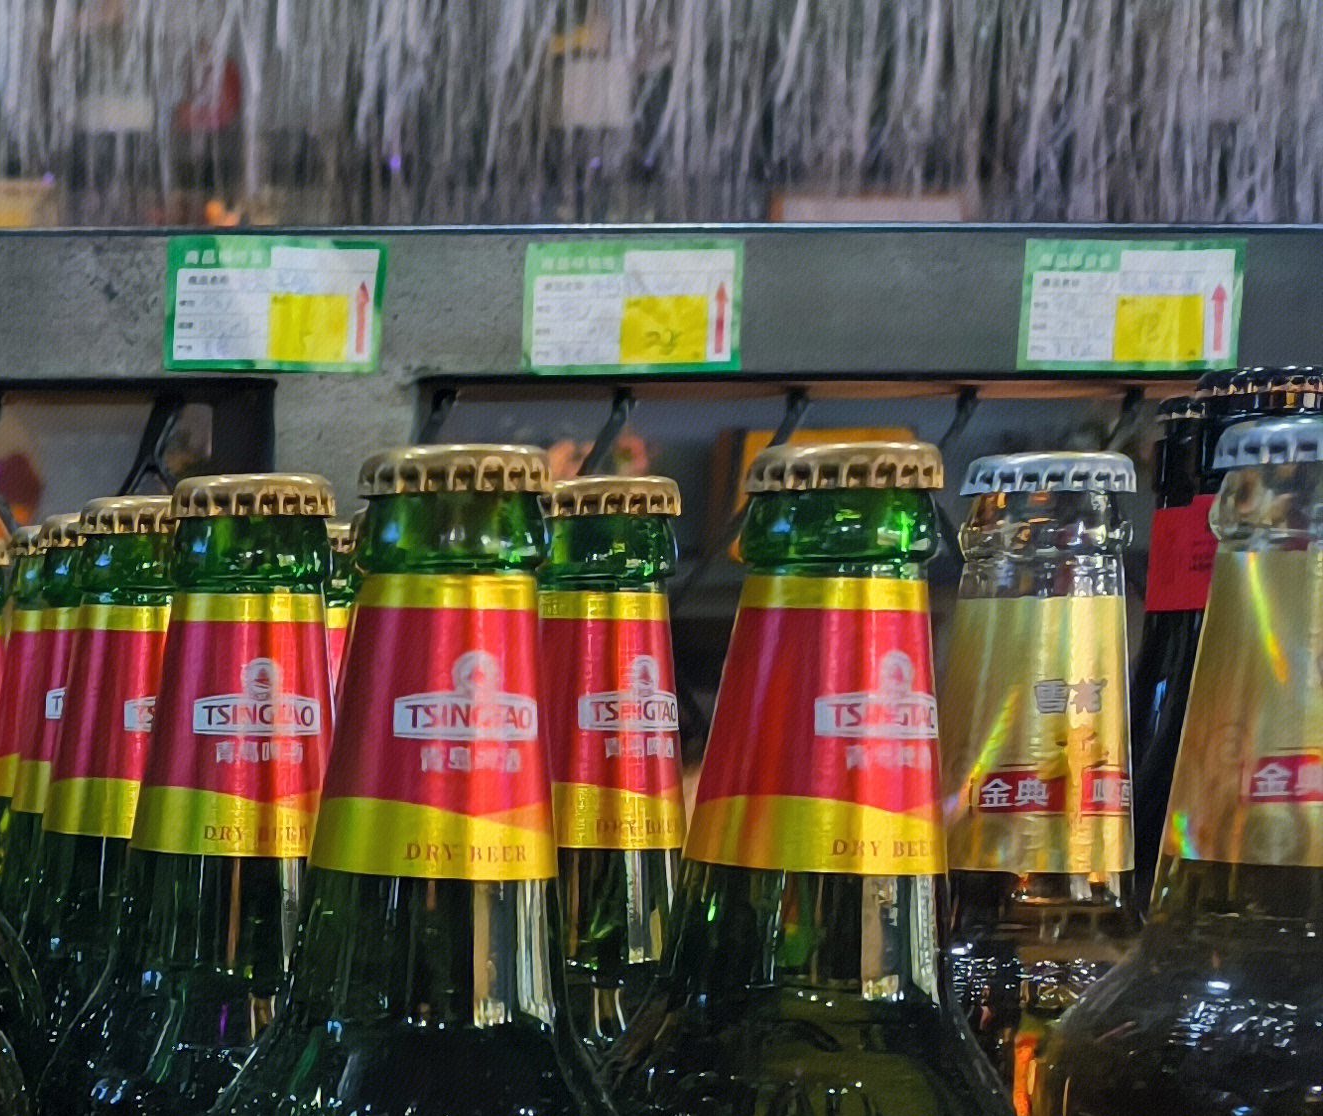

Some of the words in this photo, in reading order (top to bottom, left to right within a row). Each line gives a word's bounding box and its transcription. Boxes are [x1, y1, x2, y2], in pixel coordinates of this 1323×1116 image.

[202, 704, 316, 728] TSINGTAO
[404, 843, 455, 862] DRY
[469, 844, 528, 863] BEER
